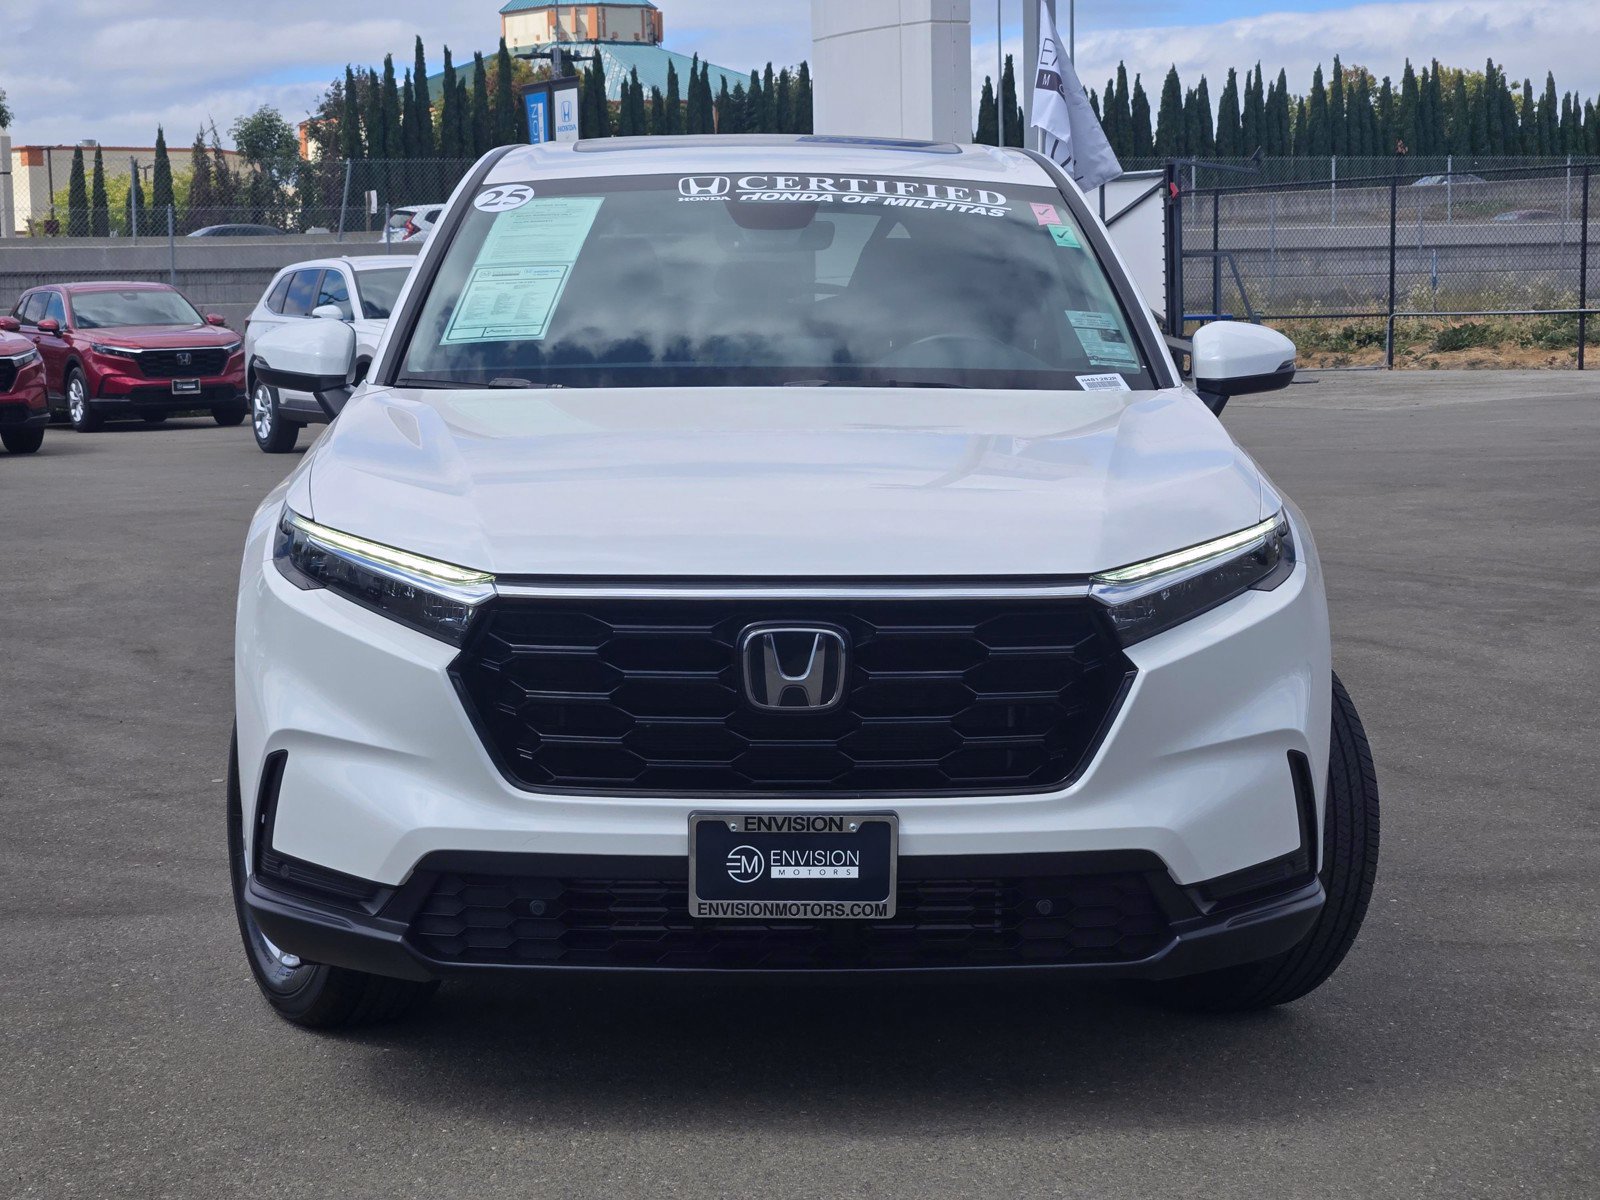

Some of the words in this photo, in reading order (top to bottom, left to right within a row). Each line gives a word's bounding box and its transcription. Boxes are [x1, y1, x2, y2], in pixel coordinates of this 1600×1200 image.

[557, 124, 576, 132] HONDA
[479, 188, 530, 207] 25
[737, 176, 1007, 206] CERTIFIED
[740, 192, 834, 203] HONDA
[842, 195, 879, 204] OF
[883, 197, 1005, 217] MILPITAS
[743, 816, 844, 832] ENVISION
[770, 850, 860, 866] ENVISION
[778, 868, 851, 876] MOTORS
[697, 902, 888, 917] ENVISIONMOTORS.COM
